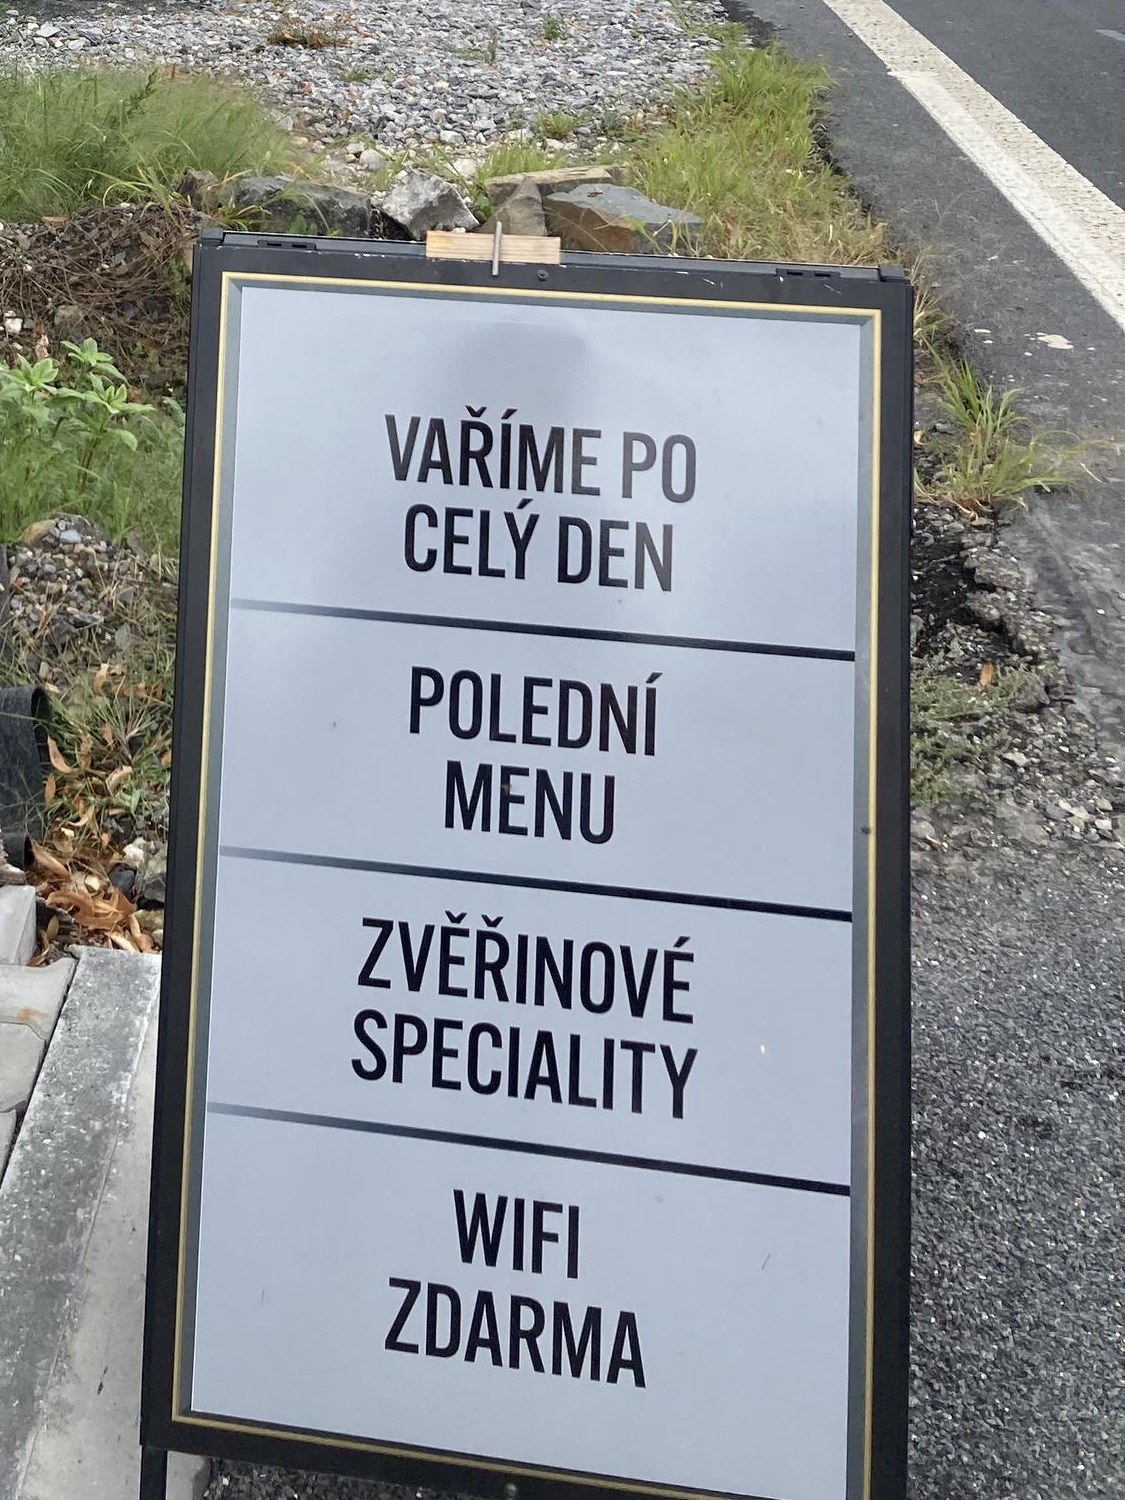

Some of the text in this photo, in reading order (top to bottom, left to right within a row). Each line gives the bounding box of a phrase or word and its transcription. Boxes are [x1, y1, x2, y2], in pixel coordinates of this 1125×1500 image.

[385, 404, 698, 504] VAŘÍME PO
[404, 498, 674, 593] CELÝ DEN
[409, 665, 663, 757] POLEDNÍ
[444, 759, 616, 845] MENU
[357, 909, 695, 1025] ZVĚŘINOVÉ
[351, 1008, 699, 1120] SPECIALITY
[453, 1188, 580, 1280] WIFI
[384, 1276, 647, 1389] ZDARMA
